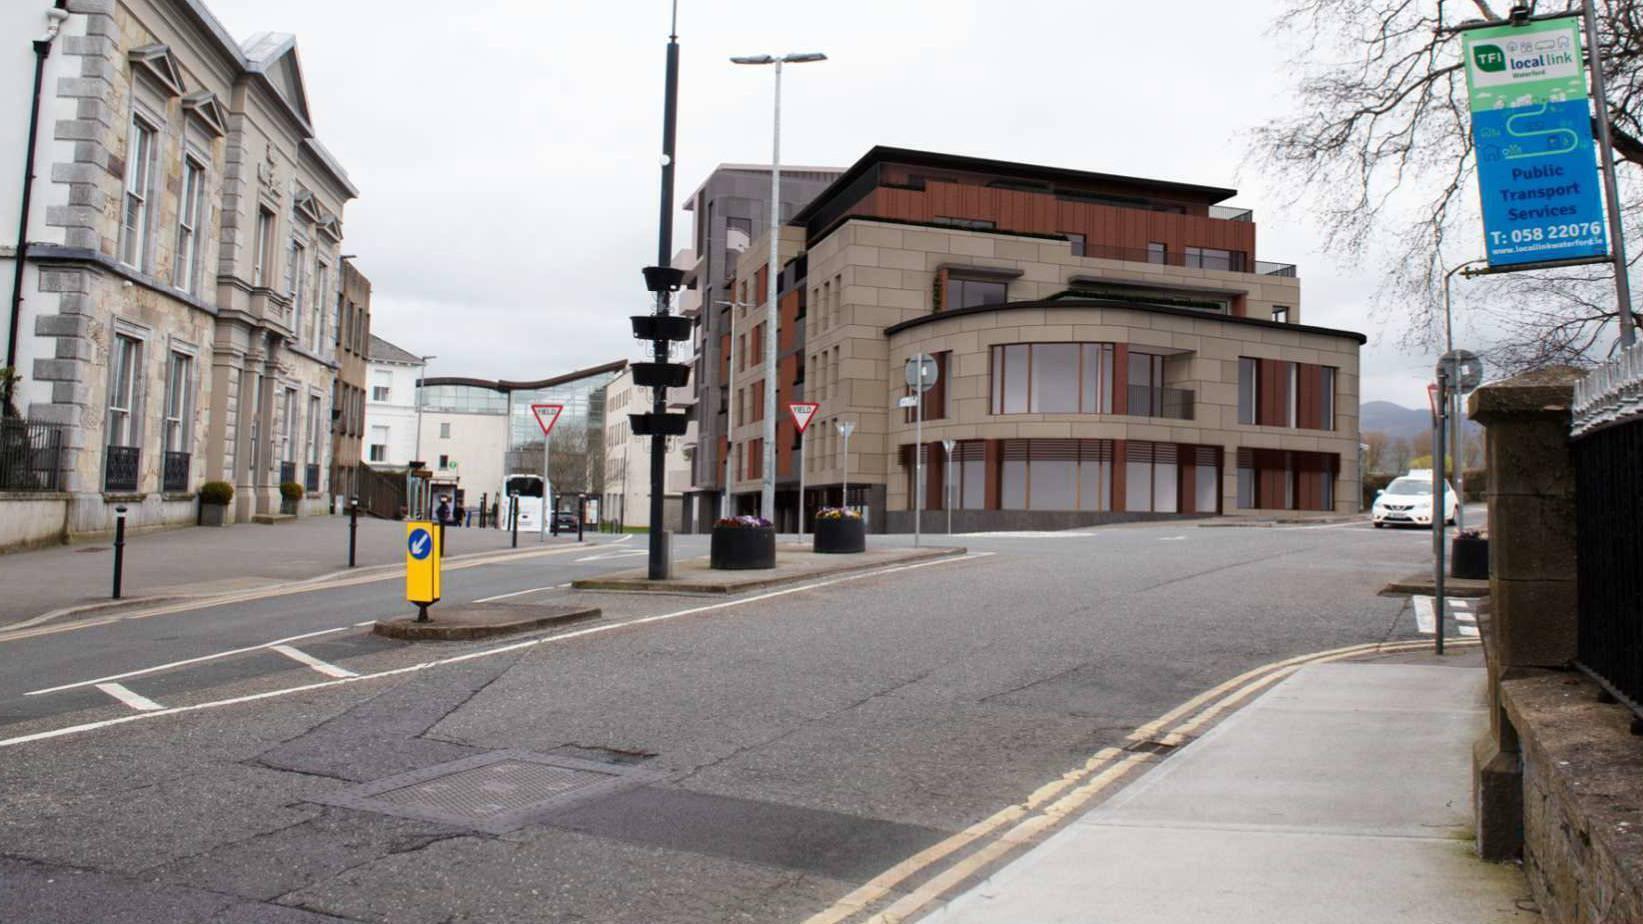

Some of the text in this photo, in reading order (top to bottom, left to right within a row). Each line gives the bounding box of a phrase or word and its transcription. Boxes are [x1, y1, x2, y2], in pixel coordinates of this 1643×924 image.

[1477, 52, 1502, 65] TFI
[1510, 52, 1573, 70] local link
[1512, 70, 1546, 79] Waterford
[1511, 164, 1565, 181] Public
[1499, 182, 1581, 202] Transport
[1507, 204, 1577, 221] Services
[1490, 221, 1601, 245] T: 058 22076
